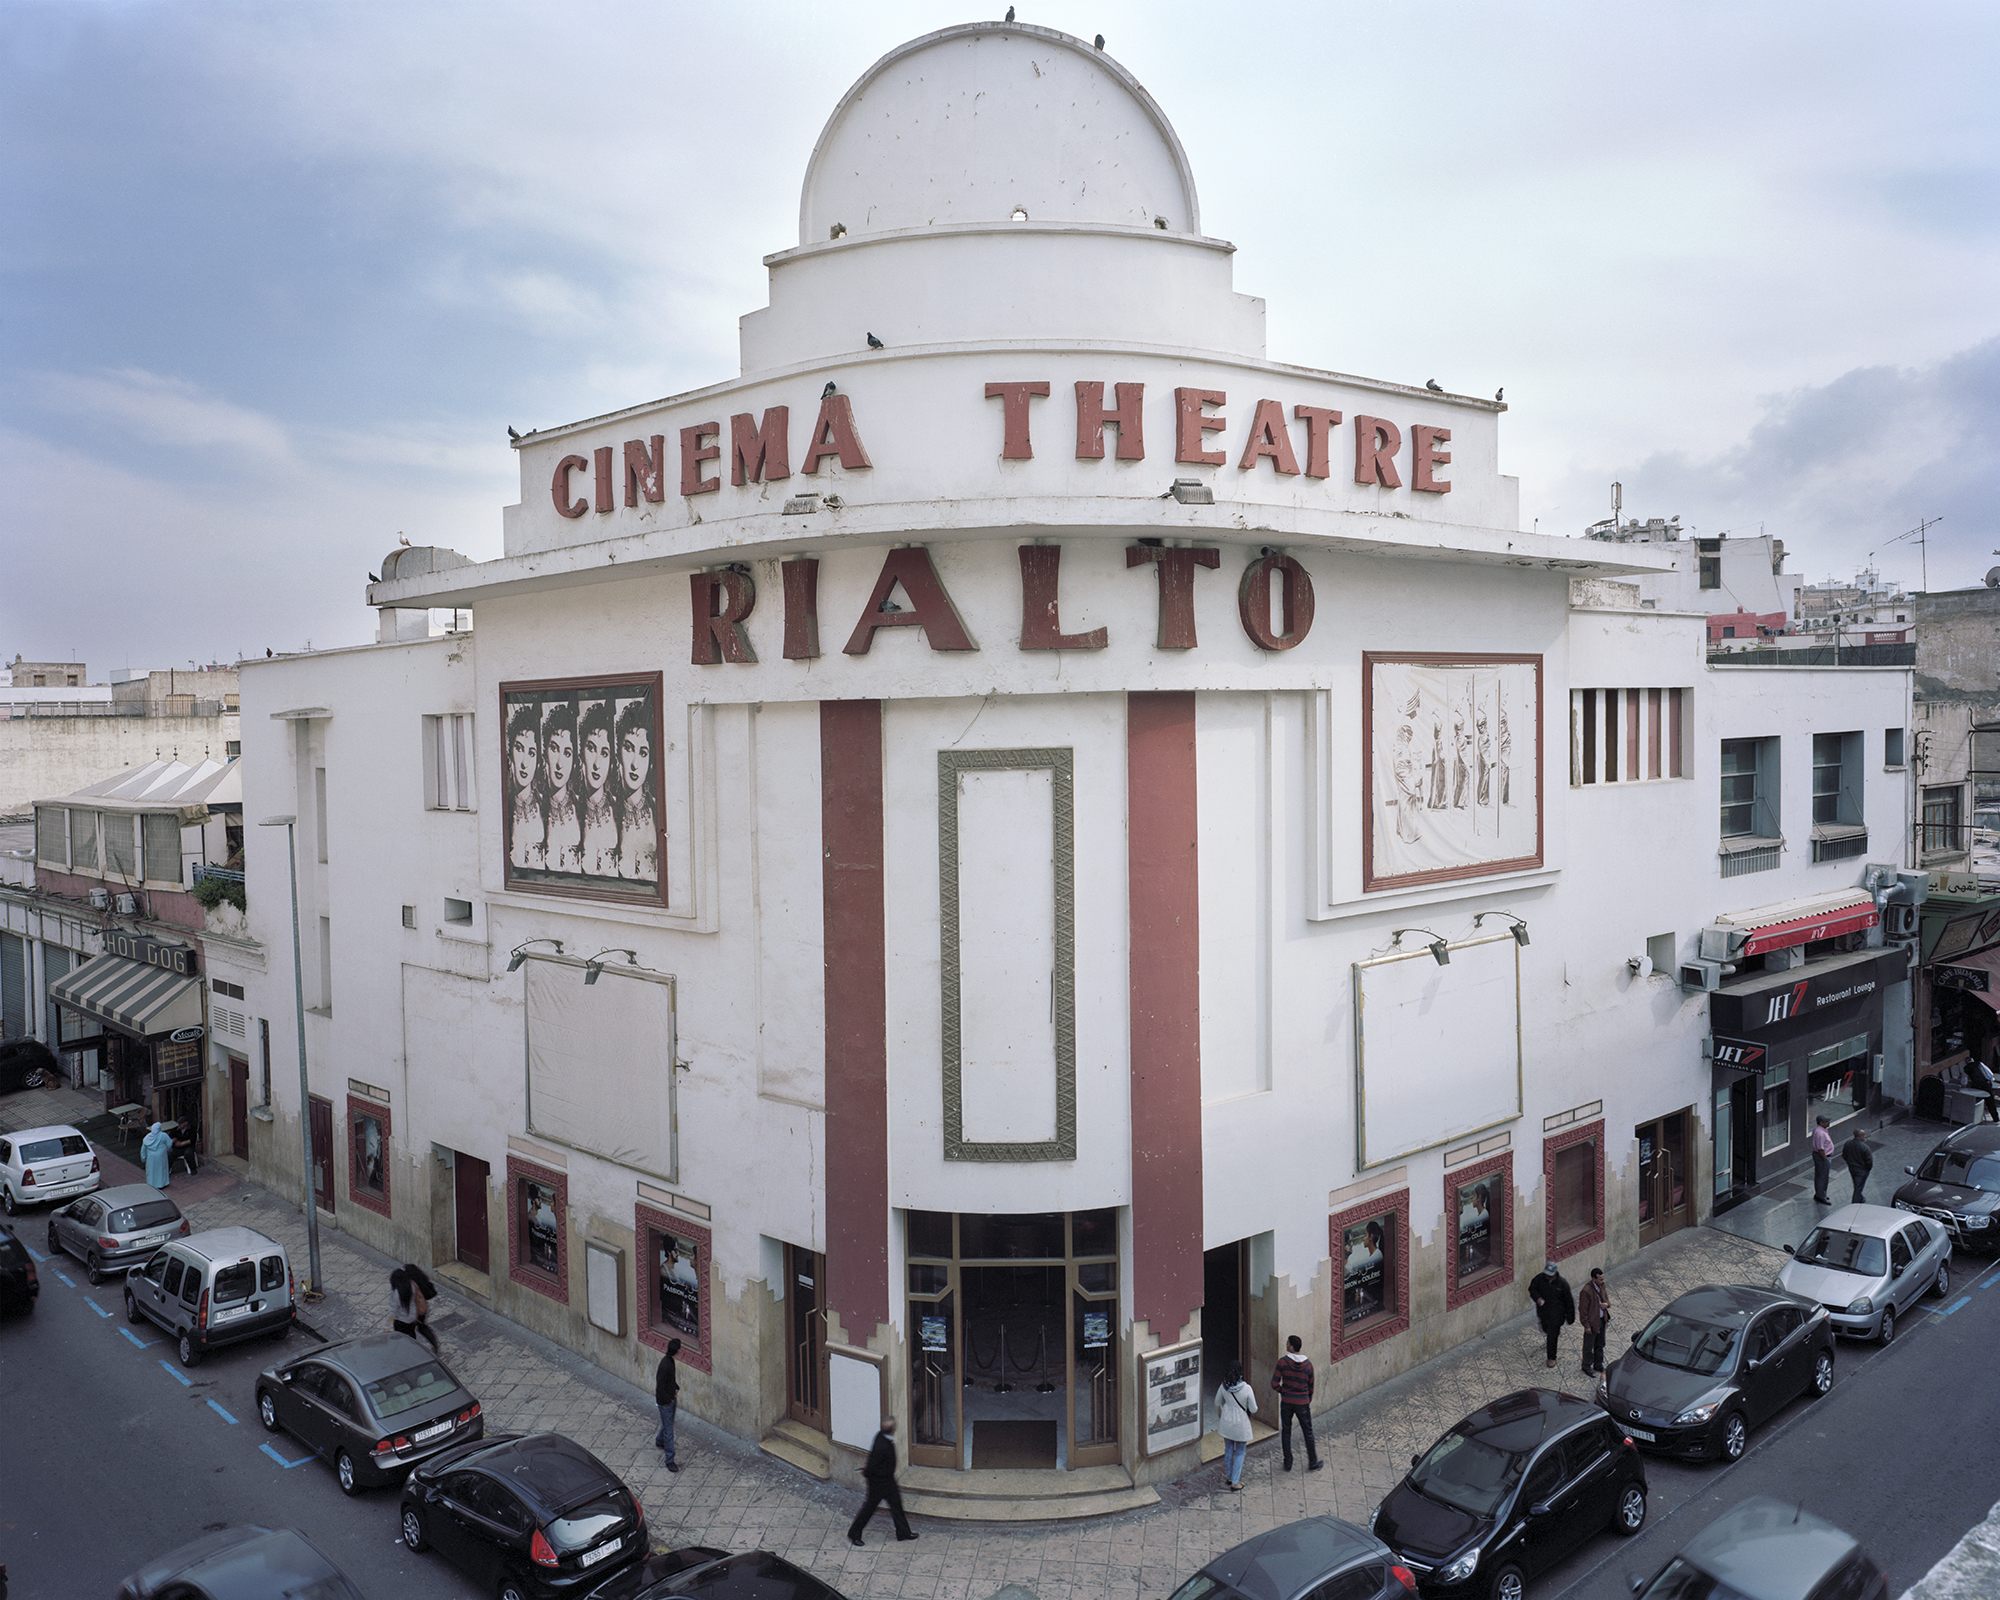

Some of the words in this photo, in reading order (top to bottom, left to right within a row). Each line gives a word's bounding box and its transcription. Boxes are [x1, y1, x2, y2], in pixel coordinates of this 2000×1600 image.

[552, 395, 873, 519] CINEMA
[984, 380, 1452, 494] THEATRE
[690, 545, 1315, 665] RIALTO
[106, 933, 137, 959] HOT
[147, 943, 184, 972] DOG
[1816, 987, 1851, 1006] Restaurant
[1853, 981, 1876, 995] Lounge
[663, 1283, 685, 1297] PASSION
